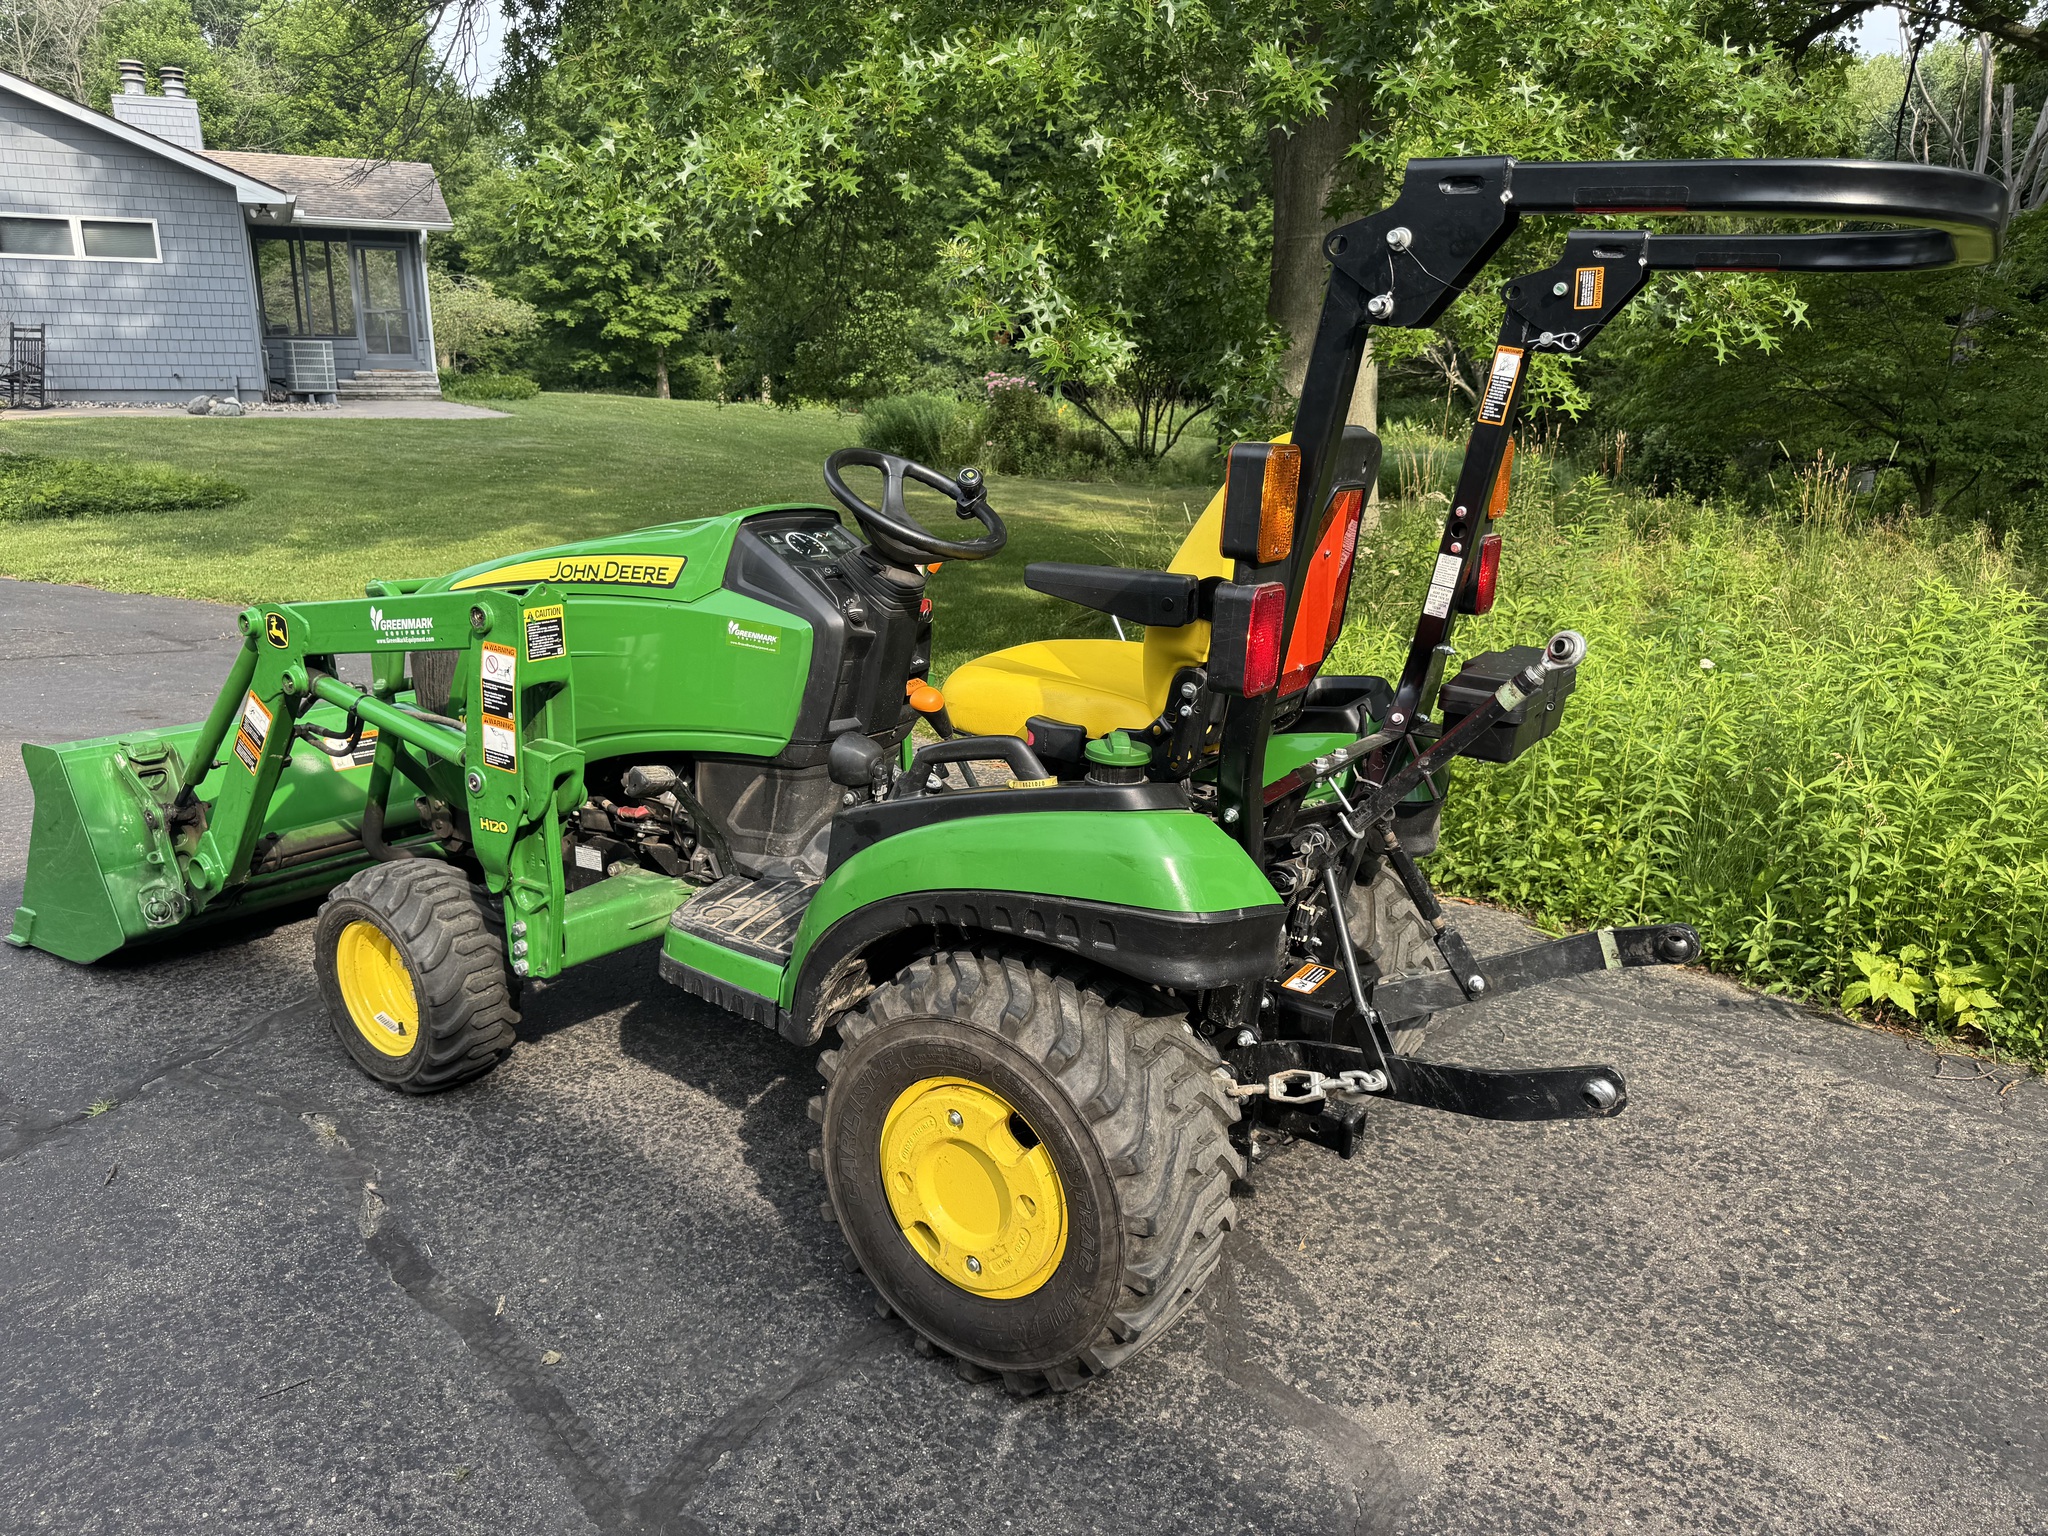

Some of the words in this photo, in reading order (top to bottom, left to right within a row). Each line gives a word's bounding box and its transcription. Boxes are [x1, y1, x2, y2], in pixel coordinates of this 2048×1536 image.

[1595, 275, 1603, 306] WARNING
[549, 561, 600, 579] JOHN
[604, 561, 669, 581] DEERE
[535, 606, 561, 618] CAUTION
[380, 617, 434, 631] GREENMARK
[384, 629, 431, 637] EQUIPMENT
[734, 629, 778, 643] GREENMARK
[488, 644, 515, 656] WARNING
[488, 717, 514, 731] WARNING
[479, 817, 509, 834] H120
[840, 1049, 901, 1206] CARLISLE
[1074, 1189, 1095, 1274] TRAC
